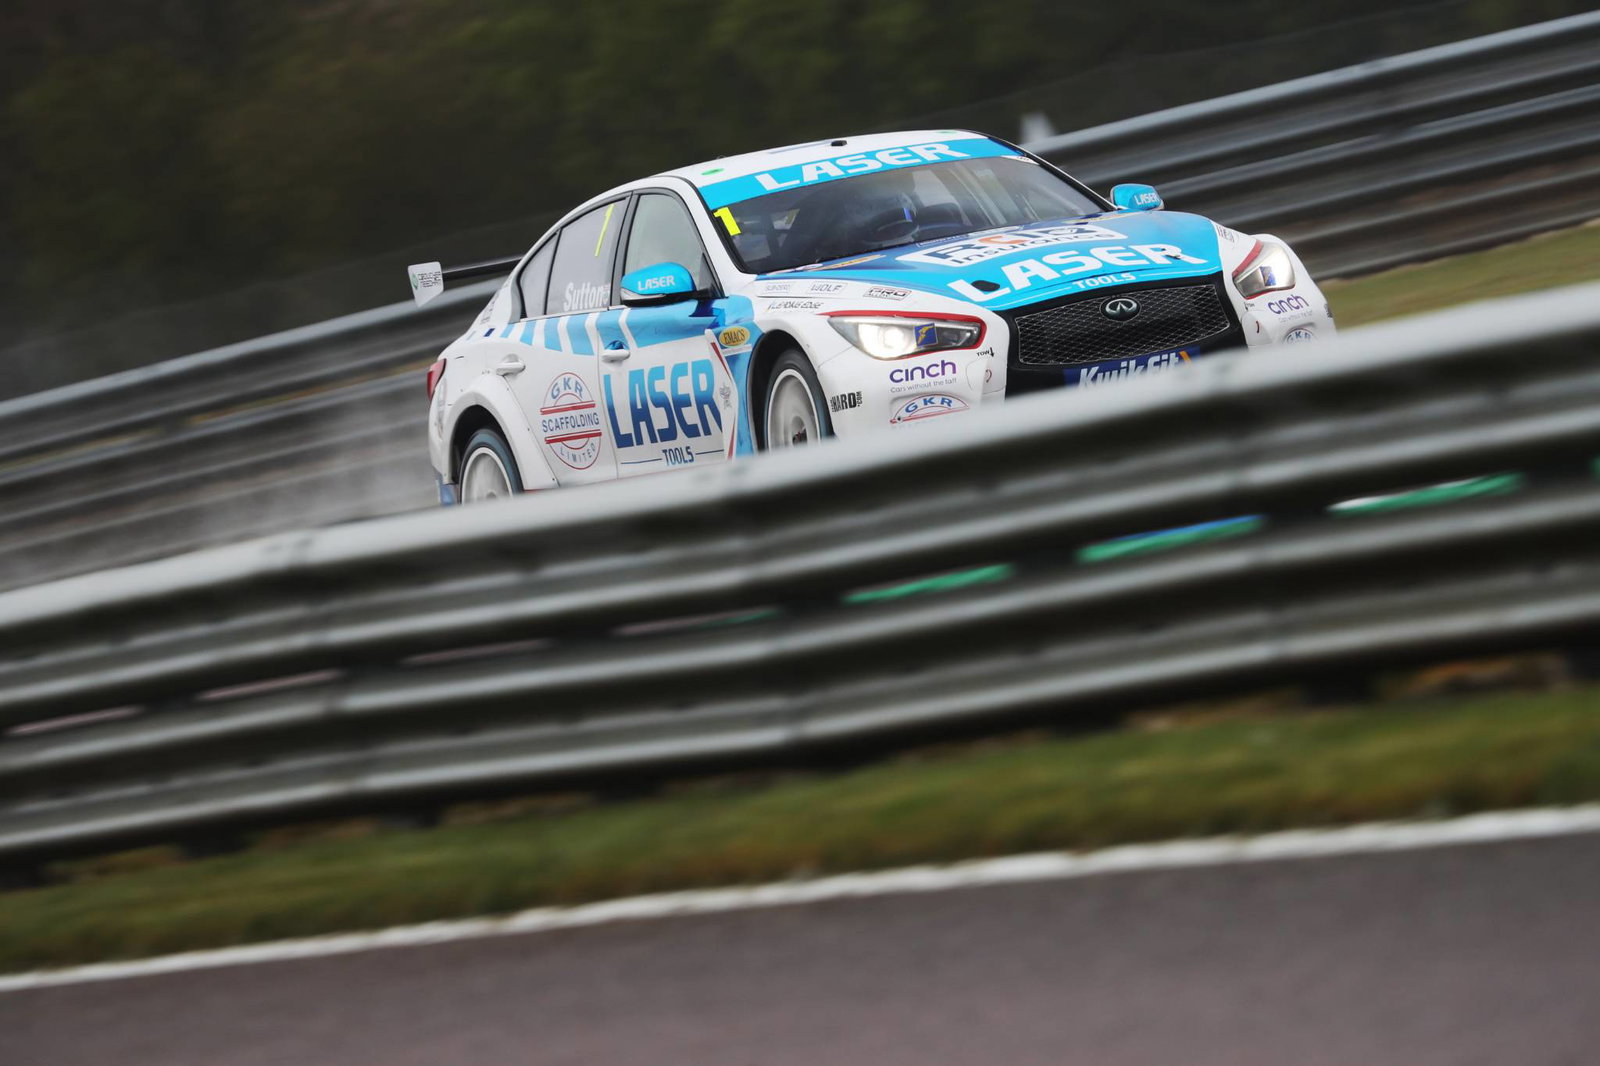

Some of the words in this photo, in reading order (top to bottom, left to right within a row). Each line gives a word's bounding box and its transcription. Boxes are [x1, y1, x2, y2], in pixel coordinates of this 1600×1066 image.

[754, 143, 971, 191] LASER
[1133, 192, 1160, 205] LASER
[594, 203, 615, 257] 1
[713, 206, 741, 237] 1
[951, 233, 1115, 264] Insurance
[637, 275, 676, 291] LASER
[946, 244, 1208, 302] LASER
[1072, 272, 1137, 290] TOOLS
[563, 282, 603, 309] Sutton
[810, 284, 843, 292] WOLF
[1267, 294, 1310, 315] cinch
[723, 329, 746, 345] EMACS
[889, 359, 957, 384] cinch
[551, 377, 583, 399] GKR
[907, 382, 932, 391] without
[603, 359, 723, 449] LASER
[904, 397, 953, 413] GKR
[542, 412, 599, 433] SCAFFOLDING
[560, 442, 597, 463] LIMITED
[662, 446, 695, 466] TOOLS
